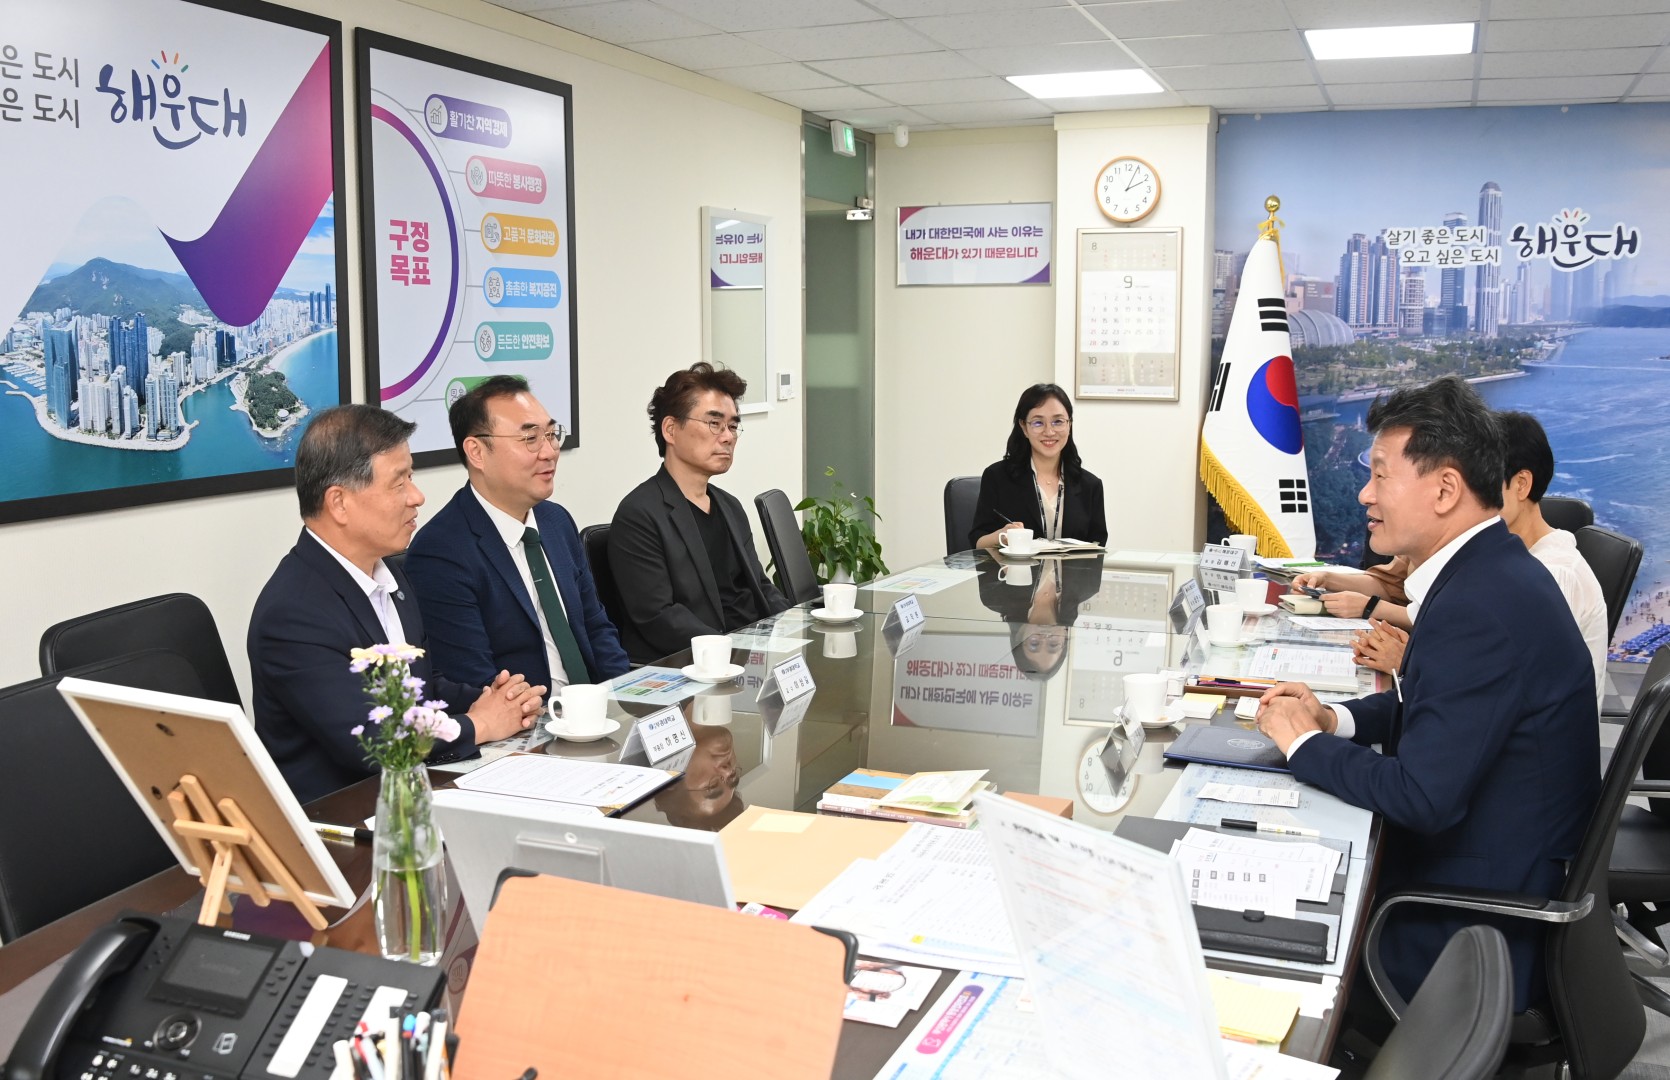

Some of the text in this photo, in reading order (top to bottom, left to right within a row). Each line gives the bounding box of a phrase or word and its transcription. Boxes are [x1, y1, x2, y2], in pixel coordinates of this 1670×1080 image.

[33, 52, 79, 88] 도시
[33, 93, 79, 128] 도시
[95, 63, 247, 150] 해운대
[450, 110, 508, 138] 활기찬 지역경제
[1114, 167, 1121, 175] 11
[1125, 163, 1133, 172] 12
[488, 170, 543, 193] 따뜻한 봉사행정
[1105, 175, 1114, 183] 10
[1144, 174, 1149, 182] 2
[1103, 185, 1109, 193] 9
[1146, 185, 1152, 194] 3
[1105, 196, 1111, 204] 8
[1113, 204, 1118, 212] 7
[1135, 204, 1140, 212] 5
[1142, 196, 1147, 204] 4
[1123, 207, 1129, 215] 6
[389, 219, 430, 253] 구정
[503, 226, 555, 246] 고품격 문화관광
[905, 225, 1043, 241] 내가 대한민국에 사는 이유는
[1387, 228, 1485, 246] 살기 좋은 도시
[909, 246, 1038, 262] 해운대가 있기 때문입니다
[1091, 242, 1097, 251] 8
[1510, 225, 1639, 268] 해운대
[1402, 248, 1499, 265] 오고 싶은 도시
[390, 254, 431, 287] 목표
[505, 280, 557, 298] 촘촘한 복지증진
[1123, 275, 1133, 289] 9
[497, 334, 550, 350] 든든한 안전확보
